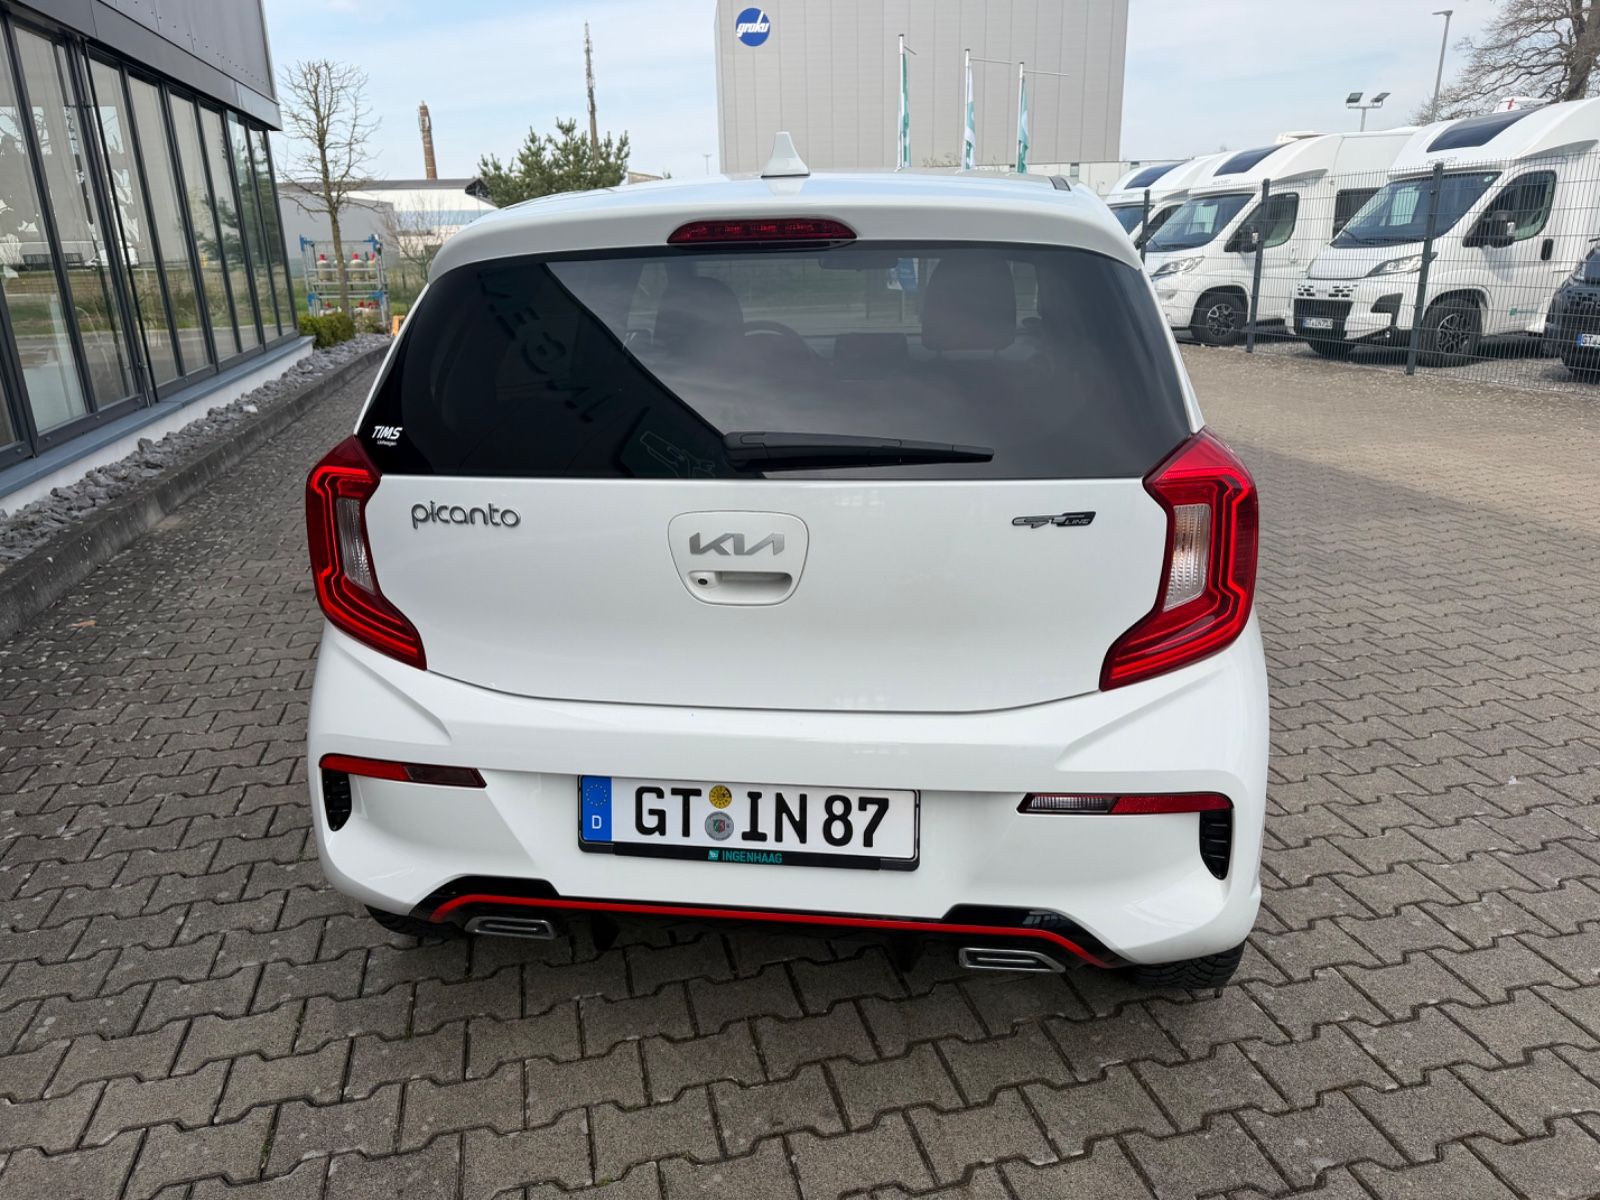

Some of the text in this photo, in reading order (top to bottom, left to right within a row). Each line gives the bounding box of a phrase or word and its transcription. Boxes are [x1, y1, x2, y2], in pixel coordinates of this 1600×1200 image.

[371, 425, 403, 440] TIMS
[411, 500, 521, 530] picanto
[688, 532, 785, 556] KIA
[591, 815, 602, 829] D
[635, 786, 702, 838] GT
[741, 791, 808, 844] IN
[822, 794, 890, 848] 87
[721, 850, 783, 864] INGENHAAG
